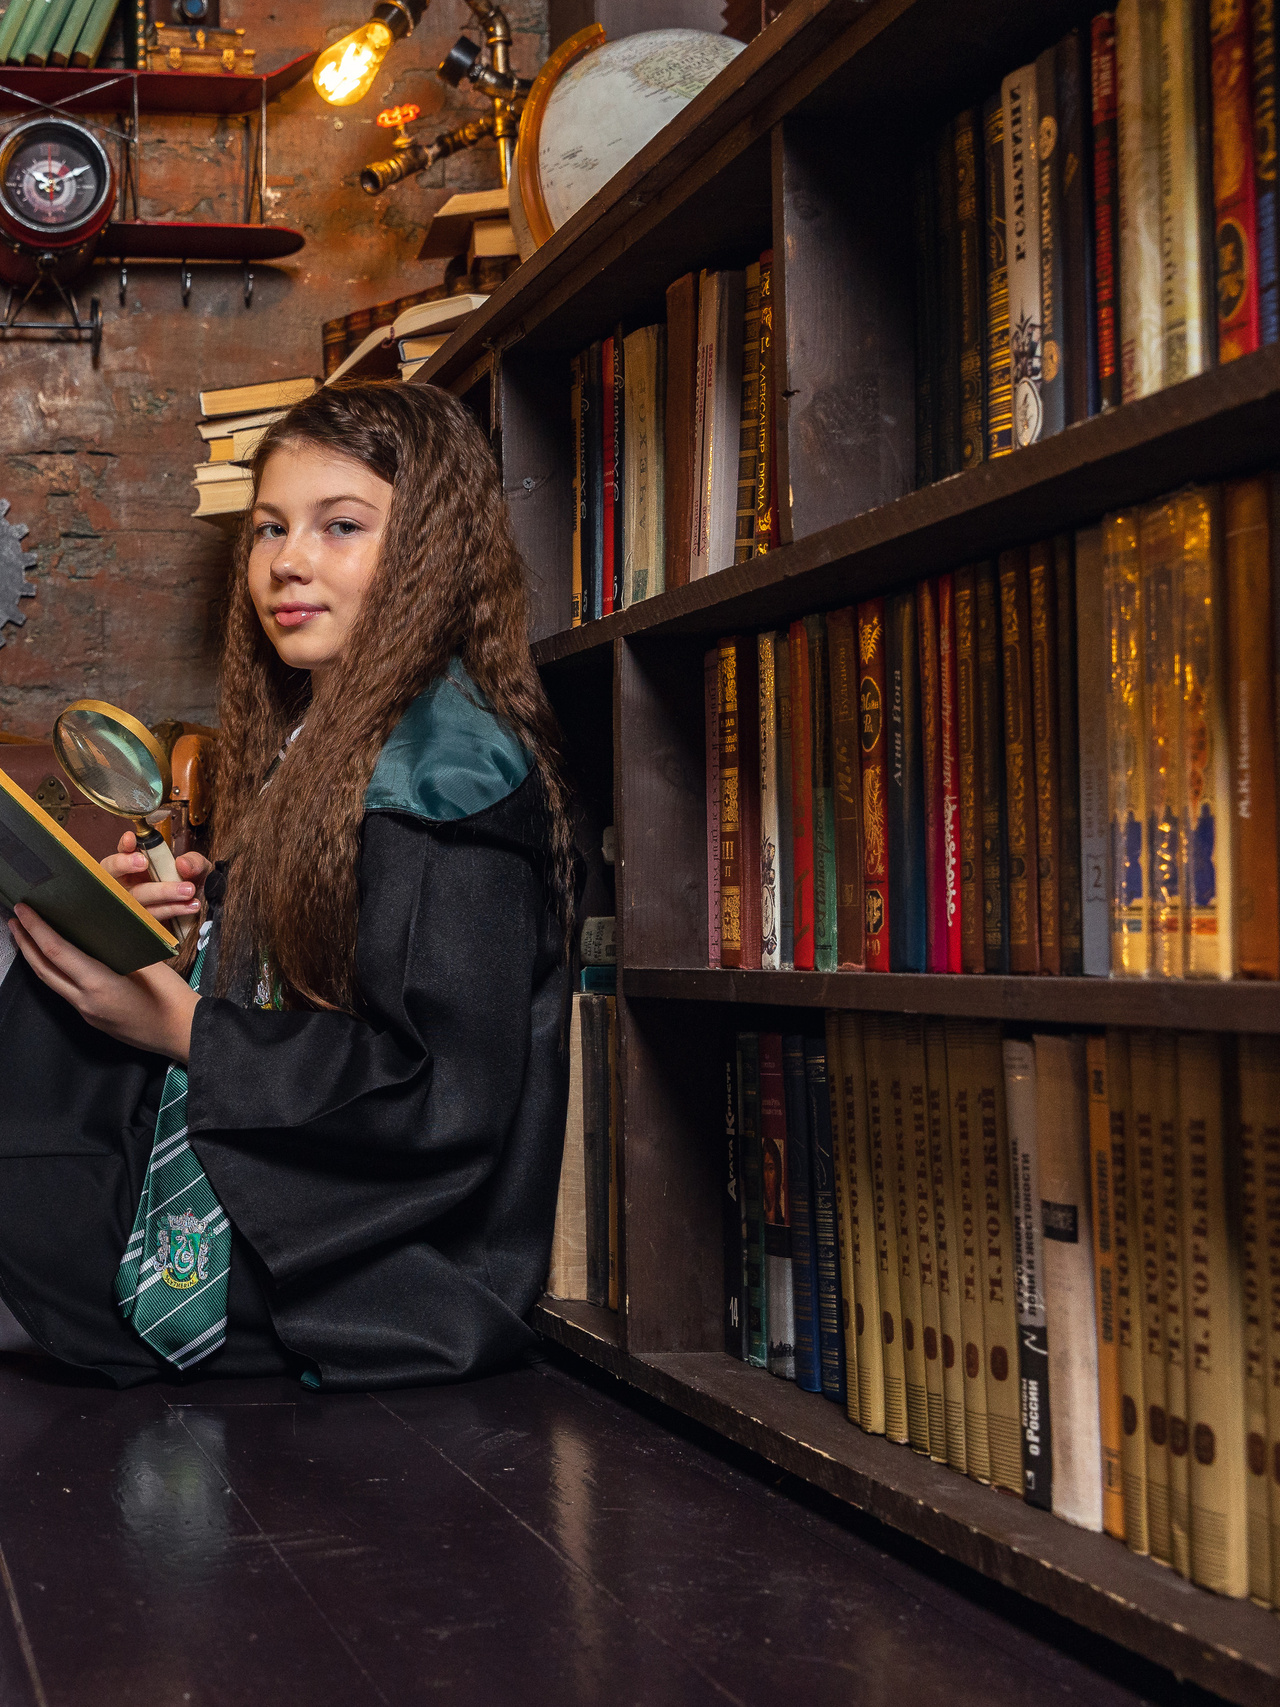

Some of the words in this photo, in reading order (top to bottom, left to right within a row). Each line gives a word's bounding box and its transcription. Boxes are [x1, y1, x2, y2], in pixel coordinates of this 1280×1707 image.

[757, 362, 768, 454] АЛЕКСАНДР
[756, 462, 766, 511] ДЮМА
[891, 668, 902, 723] Йога
[892, 731, 902, 787] Агни
[729, 1296, 739, 1328] 14
